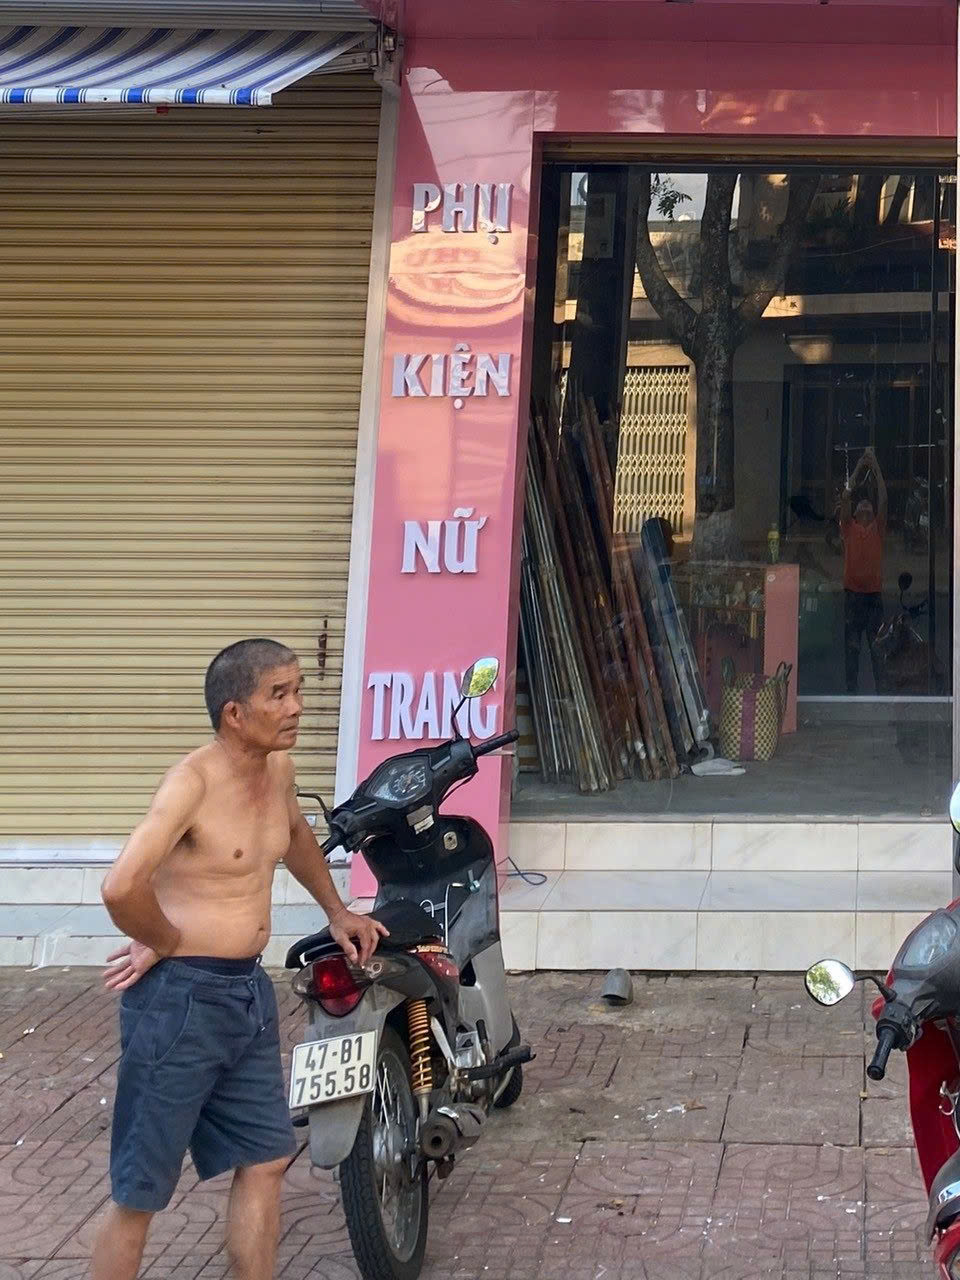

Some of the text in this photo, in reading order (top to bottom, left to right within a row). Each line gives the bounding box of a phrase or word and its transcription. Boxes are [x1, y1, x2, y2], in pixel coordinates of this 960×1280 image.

[411, 183, 514, 245] PHỤ
[392, 343, 513, 410] KIỆN
[401, 507, 490, 573] NỮ
[296, 1064, 370, 1104] 755.58
[305, 1036, 362, 1071] 47-B1
